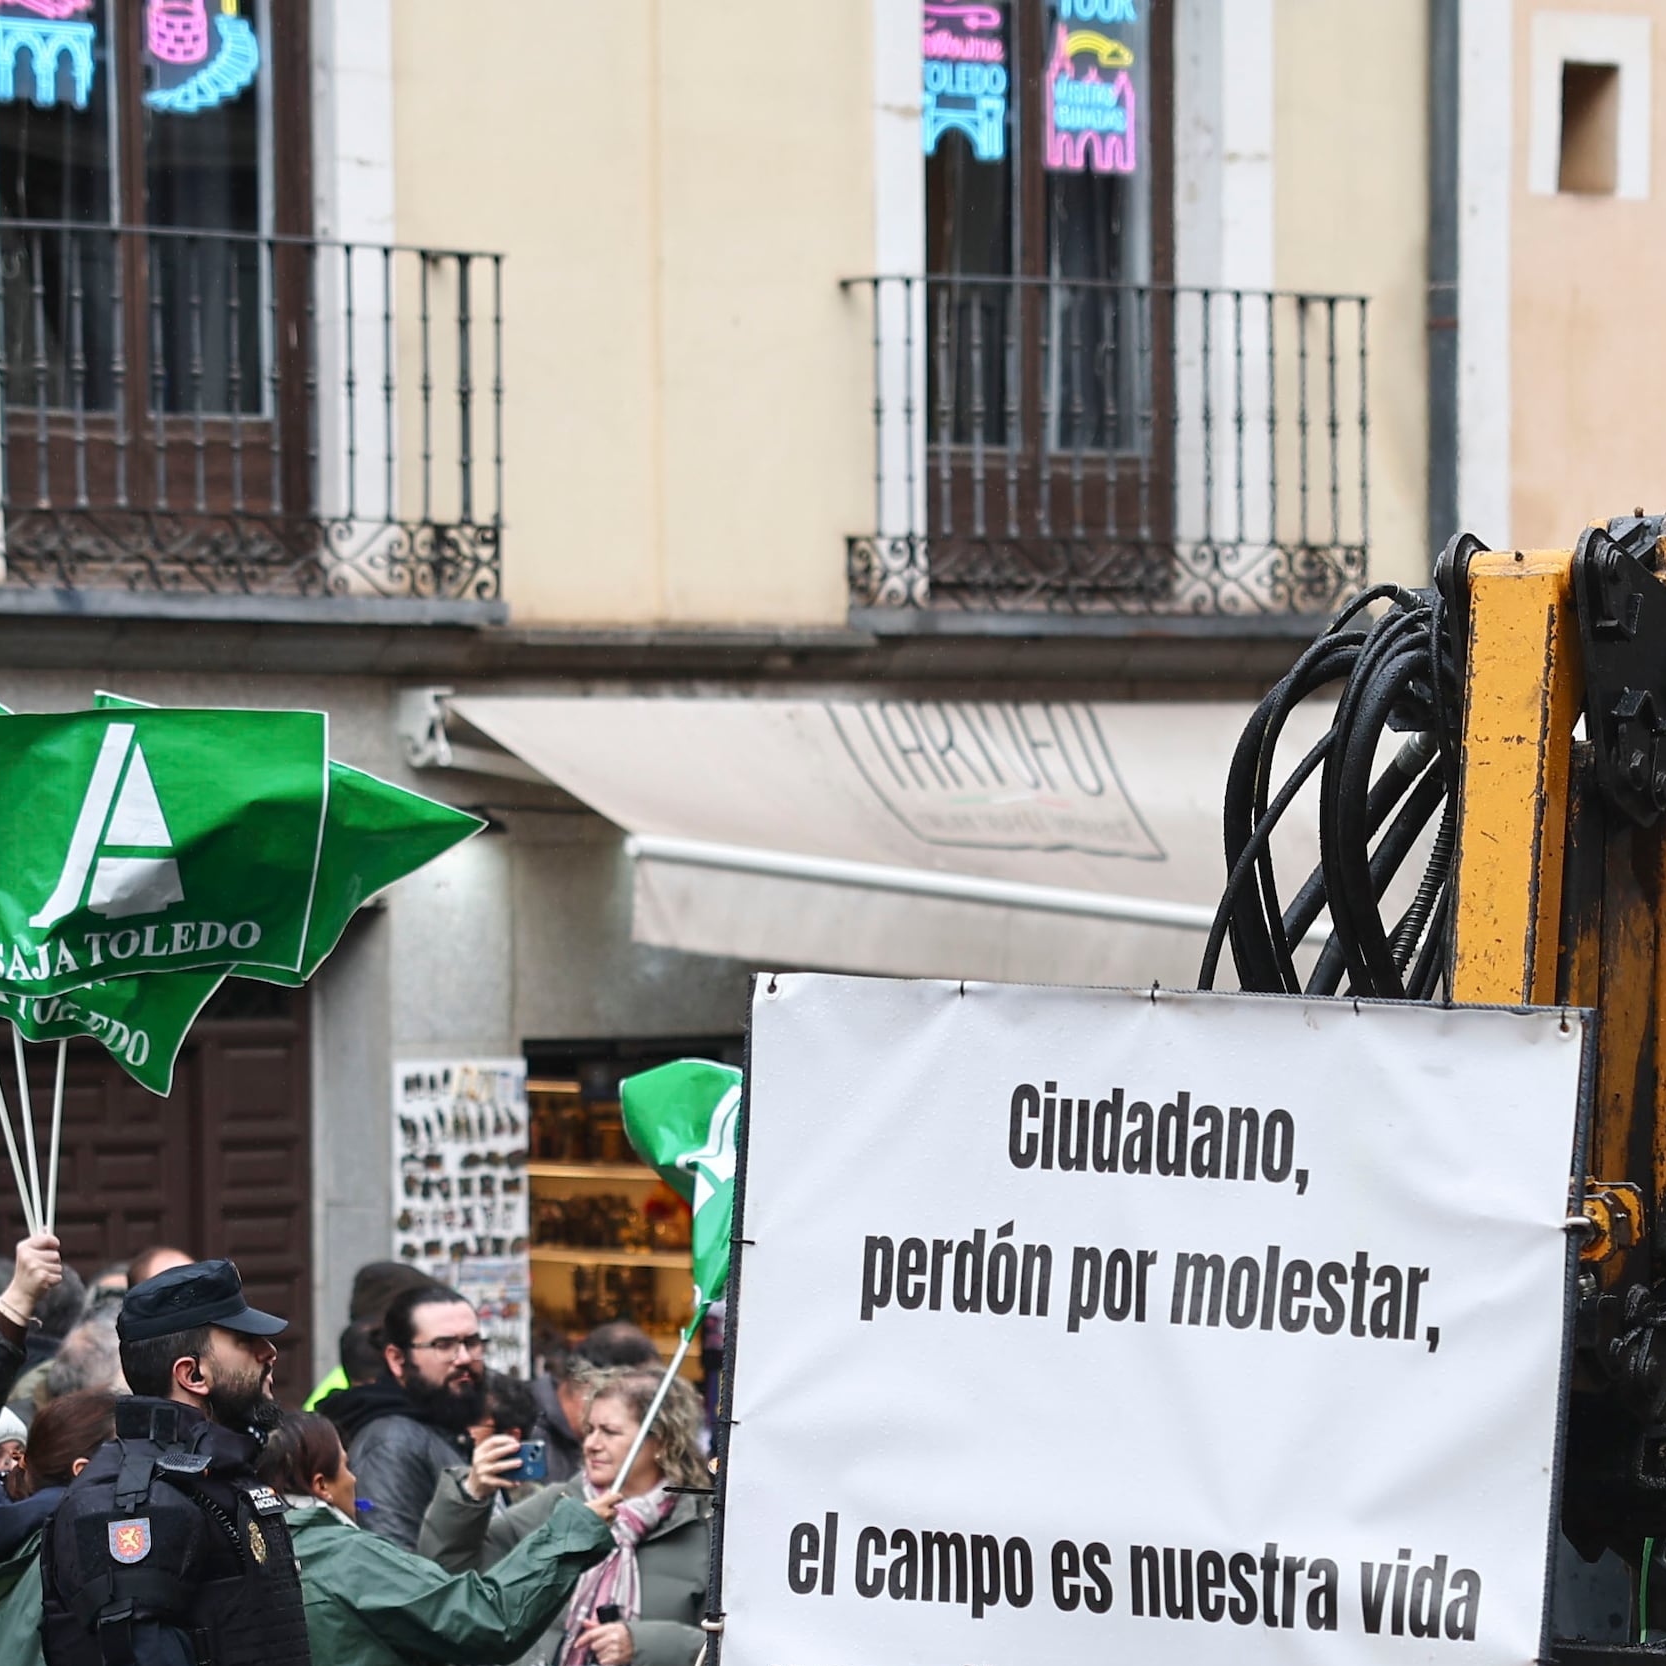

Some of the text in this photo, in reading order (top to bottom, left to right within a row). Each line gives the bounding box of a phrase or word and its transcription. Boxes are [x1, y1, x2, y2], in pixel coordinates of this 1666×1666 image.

[924, 61, 1007, 95] OLEDO
[84, 921, 263, 966] TOLEDO
[1007, 1080, 1310, 1195] Ciudadano,
[860, 1219, 1441, 1353] perdón por molestar,
[788, 1511, 1482, 1641] el campo es nuestra vida
